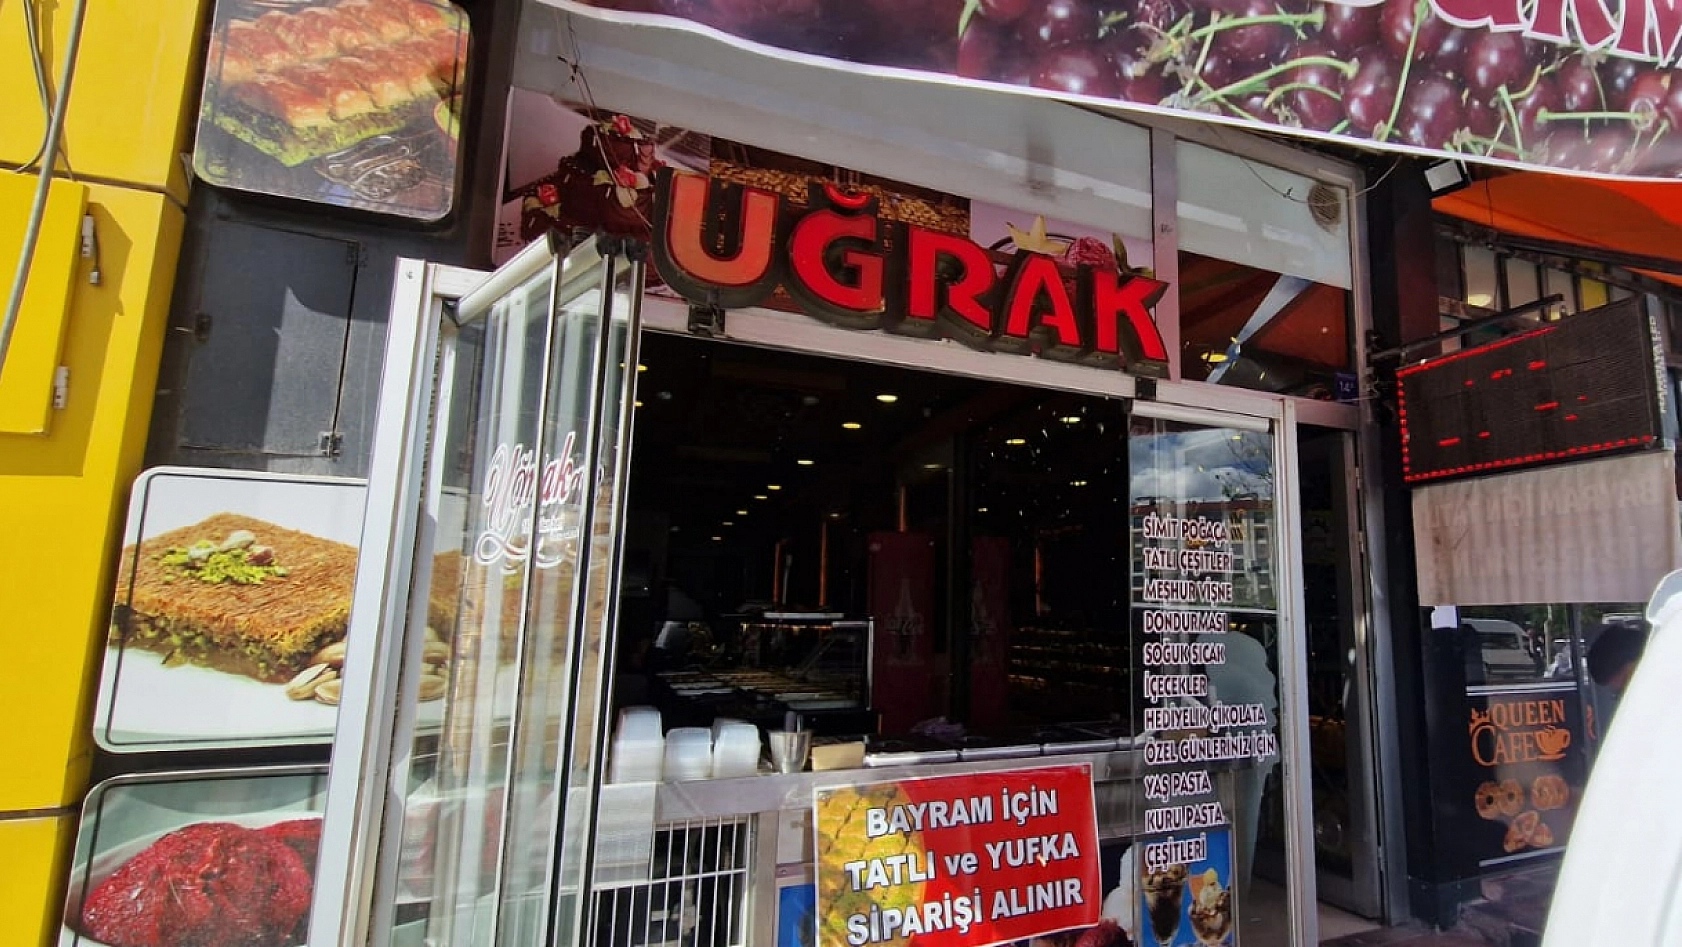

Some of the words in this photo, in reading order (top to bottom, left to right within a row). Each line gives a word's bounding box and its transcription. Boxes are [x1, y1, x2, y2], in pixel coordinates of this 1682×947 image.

[664, 168, 1169, 367] UĞRAK
[1144, 512, 1179, 539] SİMİT
[1181, 516, 1228, 548] POĞAÇA
[1143, 547, 1178, 571] TATLI
[1179, 547, 1233, 576] ÇEŞİTLERİ
[1197, 577, 1232, 608] VİŞNE
[1143, 610, 1228, 634] DONDURMASI
[1144, 638, 1189, 665] SOĞUK
[1191, 643, 1225, 664] SICAK
[1144, 671, 1207, 704] İÇECEKLER
[1144, 702, 1209, 730] HEDİYELİK
[1210, 700, 1266, 733] ÇİKOLATA
[1492, 700, 1566, 731] QUEEN
[1144, 737, 1178, 765] ÖZEL
[1180, 733, 1250, 761] GÜNLERİNİZ
[1252, 730, 1276, 761] İÇİN
[1471, 724, 1538, 767] CAFE
[1144, 773, 1169, 802] YAŞ
[1171, 770, 1211, 796] PASTA
[867, 796, 993, 838] BAYRAM
[1002, 785, 1058, 825] İÇİN
[1145, 808, 1185, 833] KURU
[1186, 802, 1225, 828] PASTA
[844, 851, 936, 892] TATLI
[944, 853, 979, 876] ve
[985, 832, 1080, 870] YUFKA
[1145, 832, 1207, 873] ÇEŞİTLERİ
[847, 887, 983, 947] SİPARİŞİ
[991, 877, 1084, 921] ALINIR
